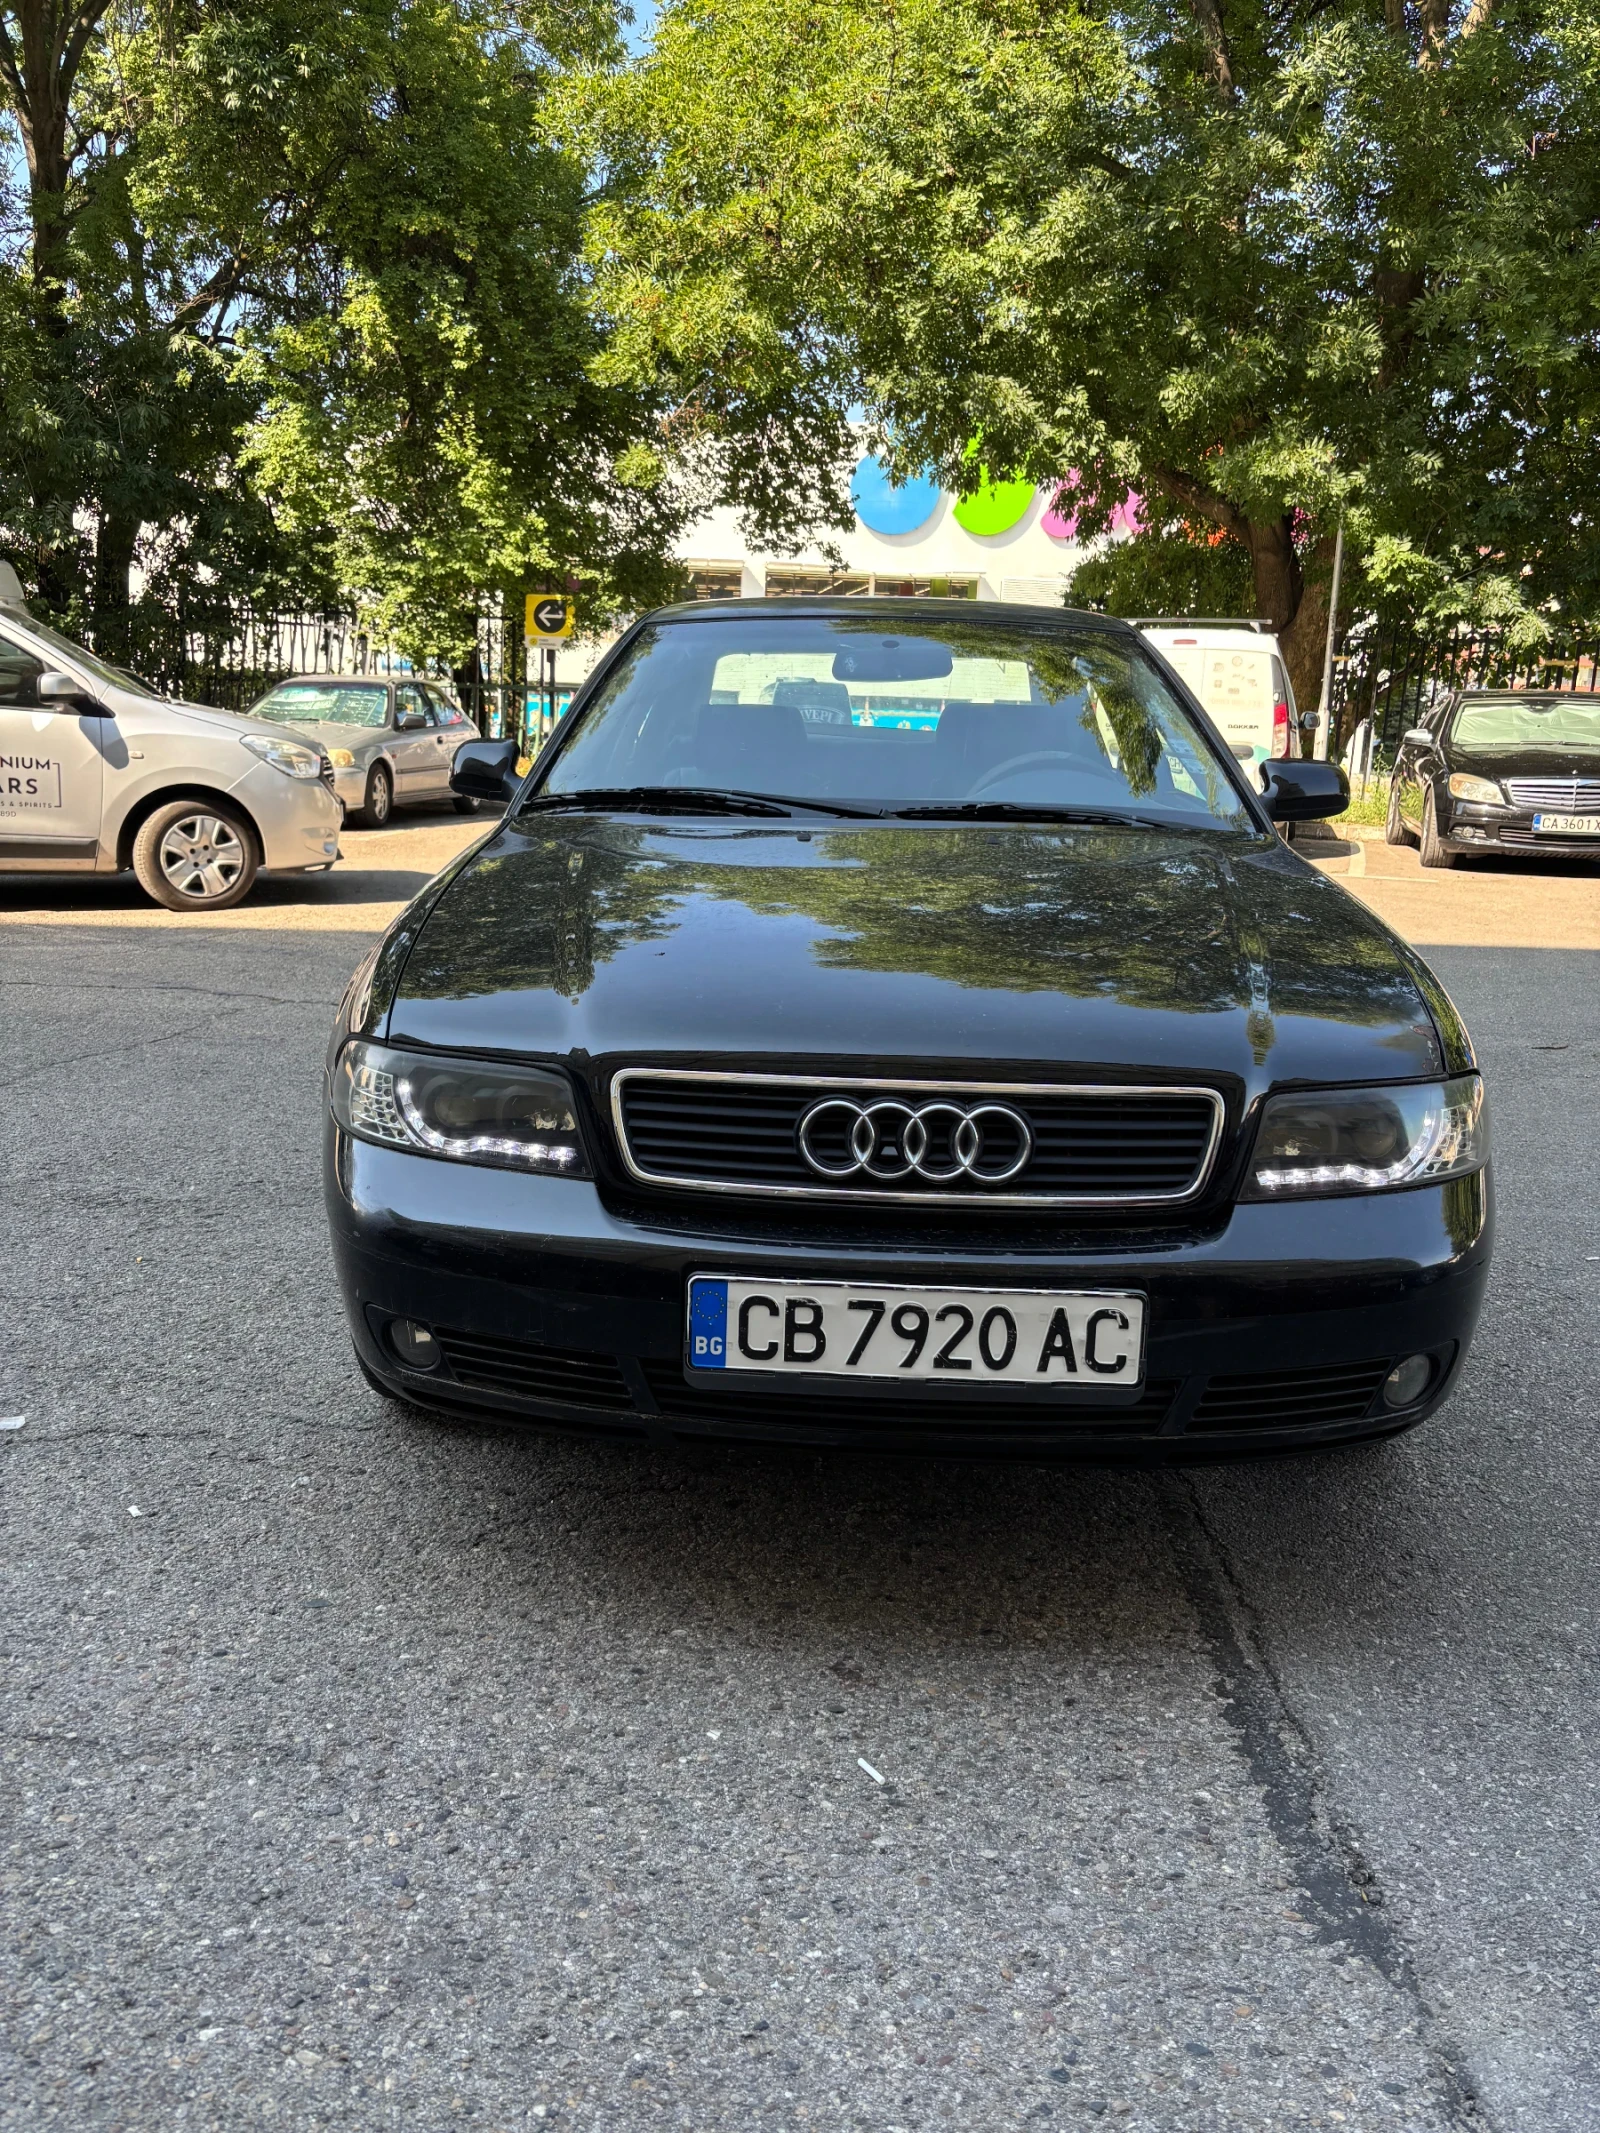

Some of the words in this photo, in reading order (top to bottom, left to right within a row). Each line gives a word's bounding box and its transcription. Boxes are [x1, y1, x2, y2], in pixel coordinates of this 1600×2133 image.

[0, 756, 50, 770] NIUM
[1542, 817, 1558, 829] CA
[1560, 818, 1591, 830] 3601
[695, 1336, 723, 1357] BG
[738, 1294, 827, 1363] CB
[845, 1298, 1018, 1372] 7920
[1036, 1306, 1130, 1374] AC
